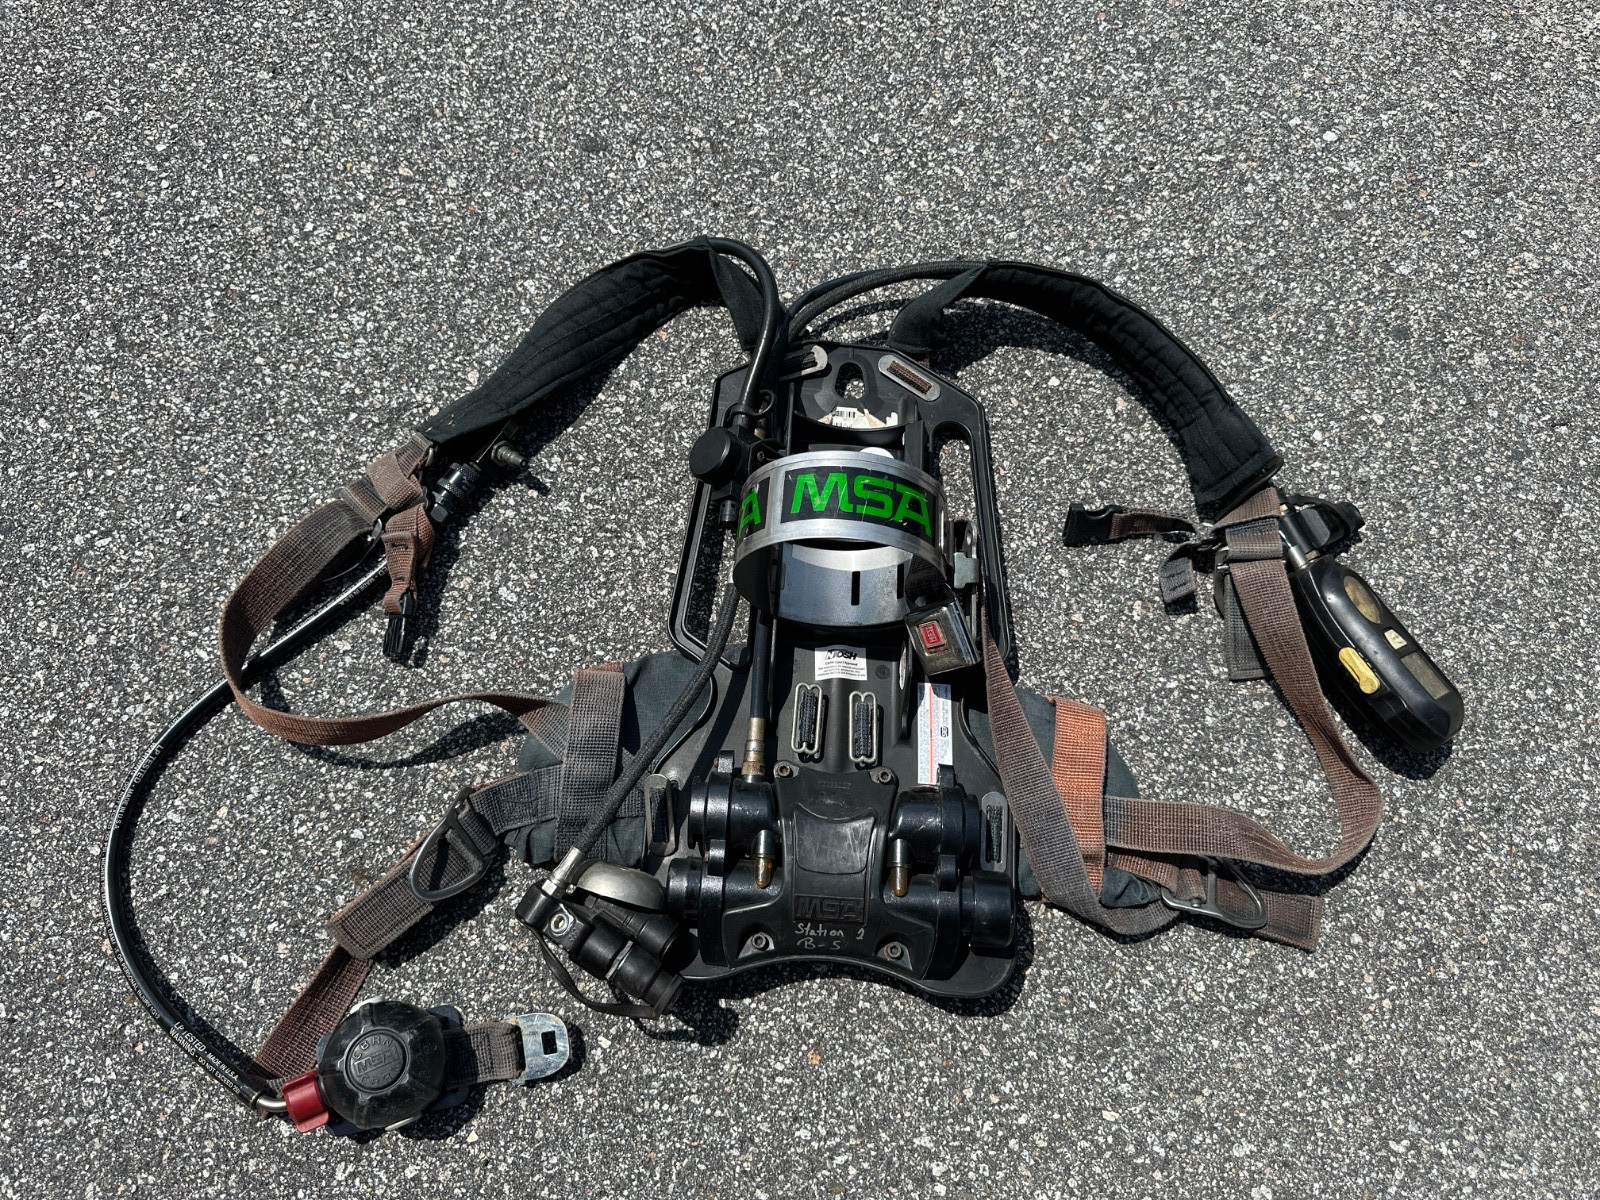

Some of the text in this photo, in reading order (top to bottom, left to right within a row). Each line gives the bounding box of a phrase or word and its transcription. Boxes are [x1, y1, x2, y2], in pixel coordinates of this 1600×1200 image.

[790, 472, 932, 538] MSA
[825, 648, 858, 660] NIOSH
[133, 756, 156, 784] TESTED
[102, 907, 112, 929] CAUSE
[796, 896, 862, 921] MSA
[794, 922, 865, 940] Station 2
[174, 1021, 184, 1030] LP
[206, 1053, 222, 1066] MADE
[353, 1035, 394, 1060] CBRN
[169, 1027, 196, 1056] WARNING
[198, 1057, 206, 1066] DO
[206, 1063, 216, 1075] NOT
[215, 1071, 234, 1088] EXCEED
